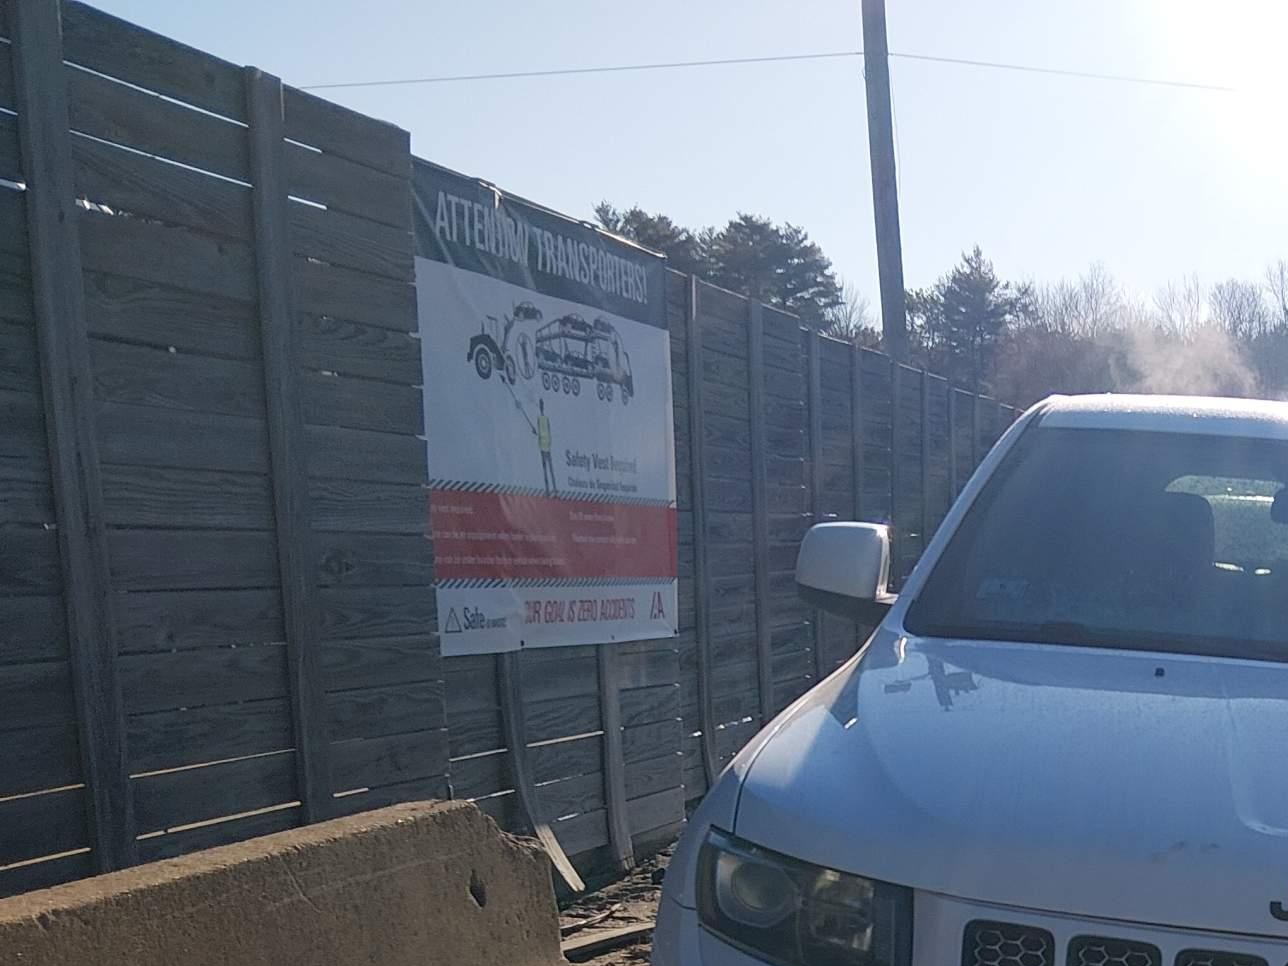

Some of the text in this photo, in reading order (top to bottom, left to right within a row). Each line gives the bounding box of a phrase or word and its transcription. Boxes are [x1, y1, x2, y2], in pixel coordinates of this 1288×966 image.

[533, 227, 648, 304] TRANSPORTERS!
[565, 449, 591, 472] Safety
[464, 606, 486, 630] Safe
